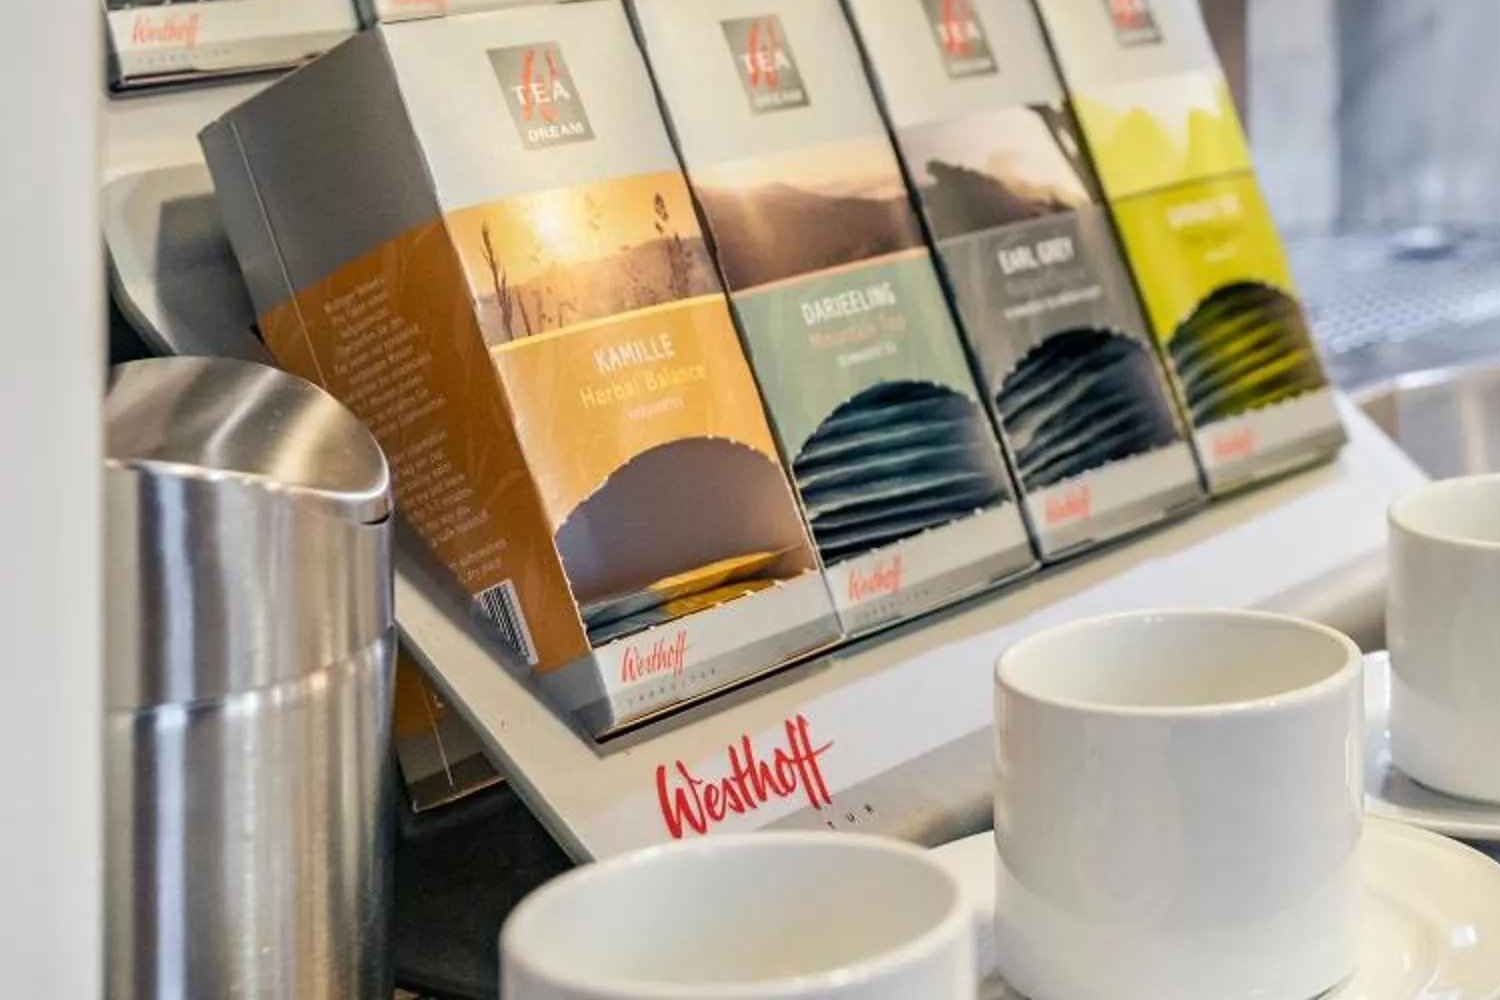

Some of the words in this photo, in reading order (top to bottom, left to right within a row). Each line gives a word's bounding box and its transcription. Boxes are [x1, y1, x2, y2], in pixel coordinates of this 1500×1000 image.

[738, 49, 792, 74] TEA
[511, 80, 571, 105] TEA
[527, 121, 585, 143] DREAM
[593, 333, 677, 376] KAMILLE
[579, 374, 641, 410] Herbal
[621, 629, 688, 684] Westhoff
[655, 713, 835, 840] Westhoff
